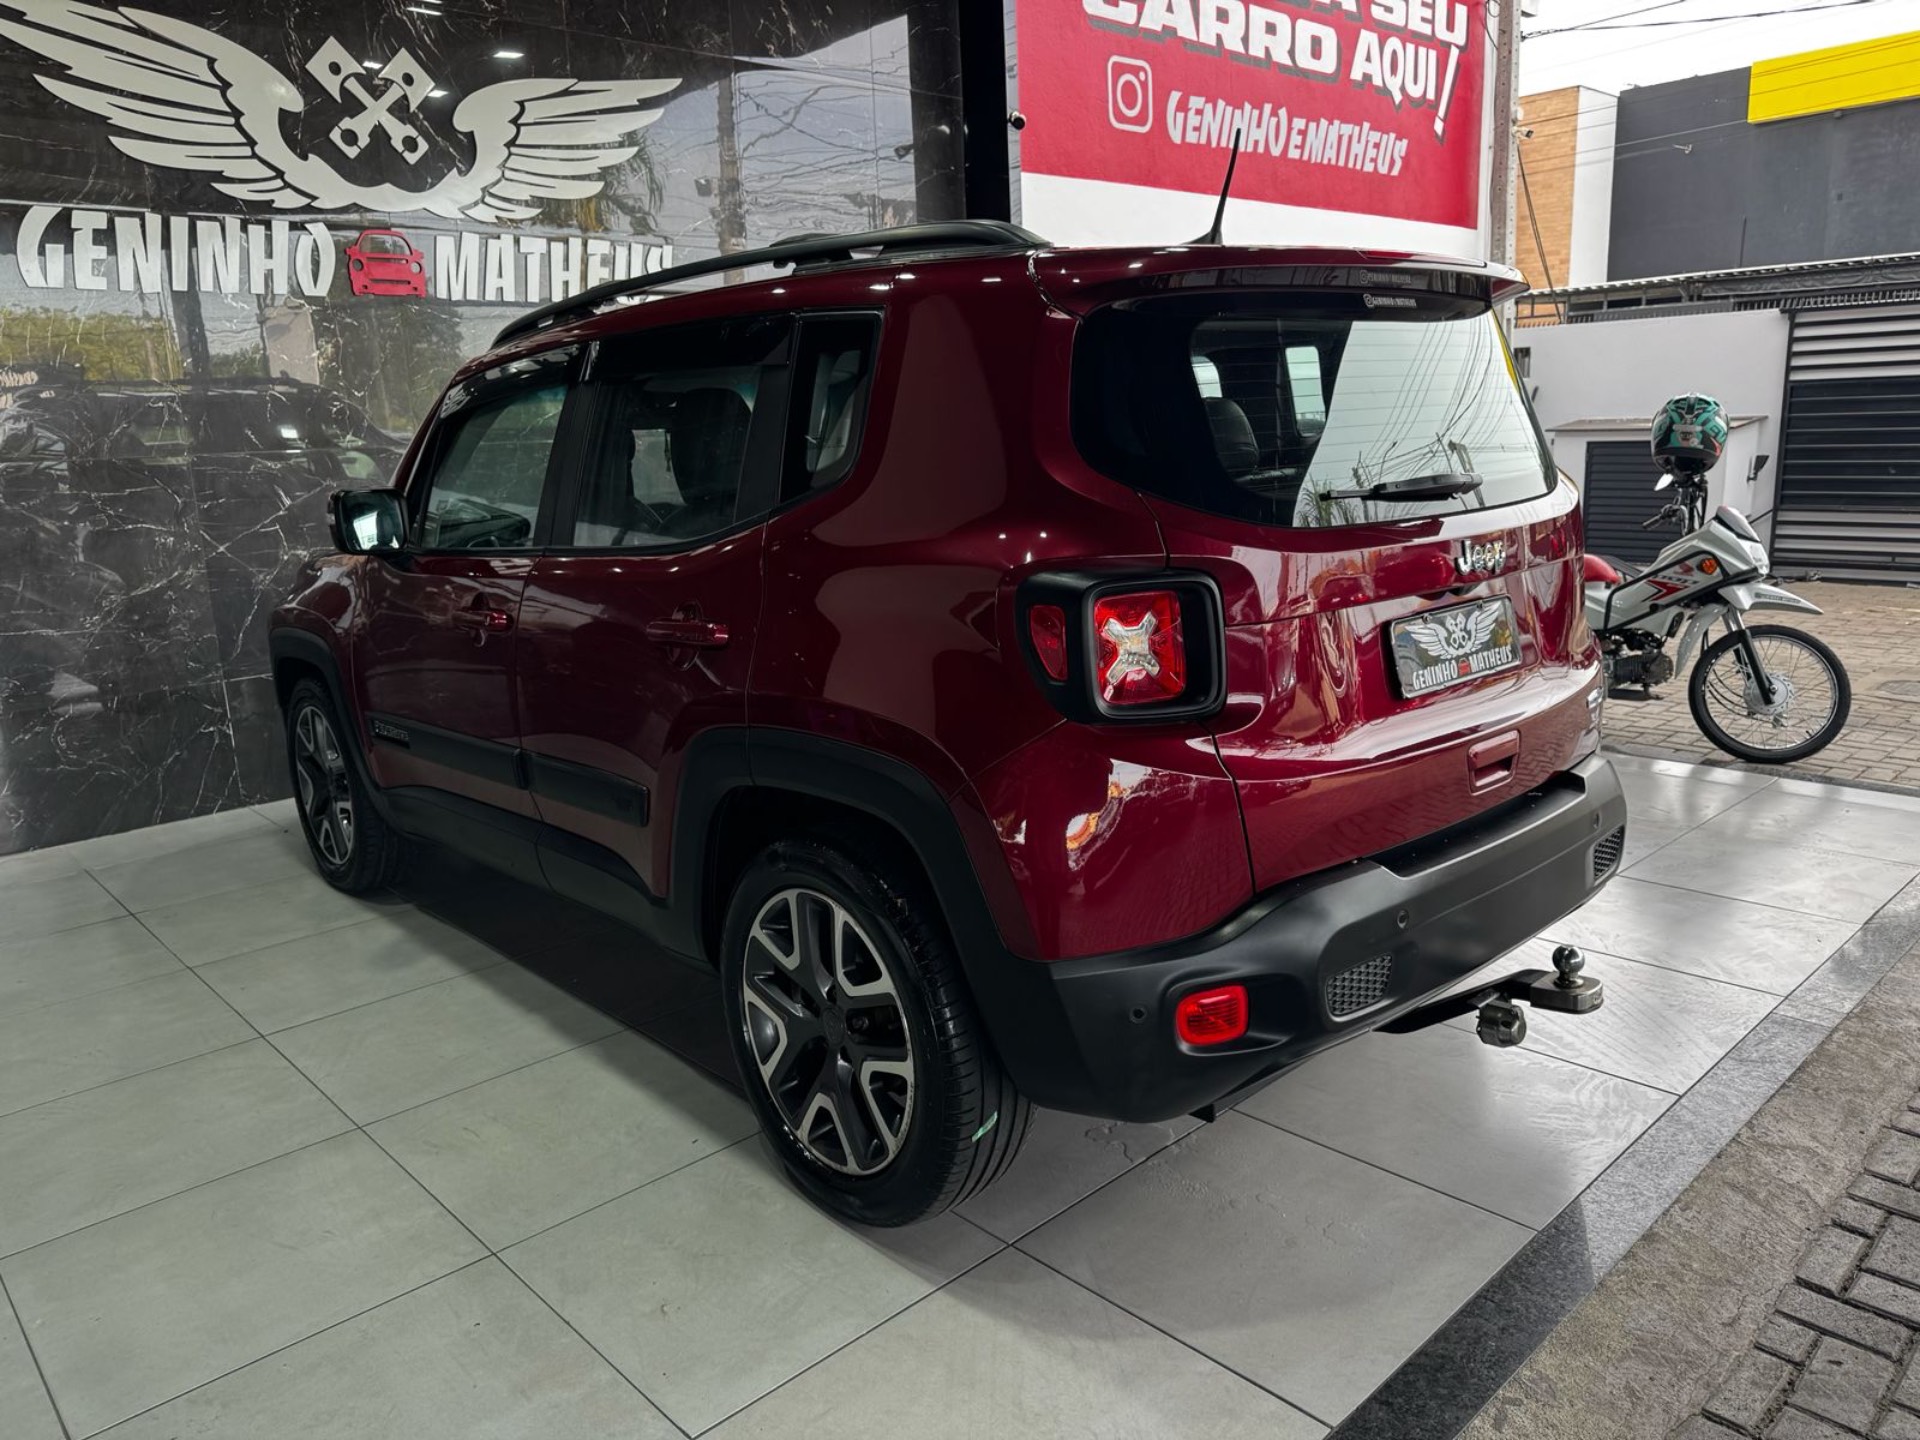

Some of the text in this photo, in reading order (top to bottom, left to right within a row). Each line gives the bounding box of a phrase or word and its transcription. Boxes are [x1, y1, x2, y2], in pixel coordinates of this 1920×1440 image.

[1371, 0, 1468, 46] SEU
[16, 205, 336, 297] GENINHO
[1454, 540, 1506, 575] Jeep
[1412, 644, 1513, 690] GENINHO MATHEUS
